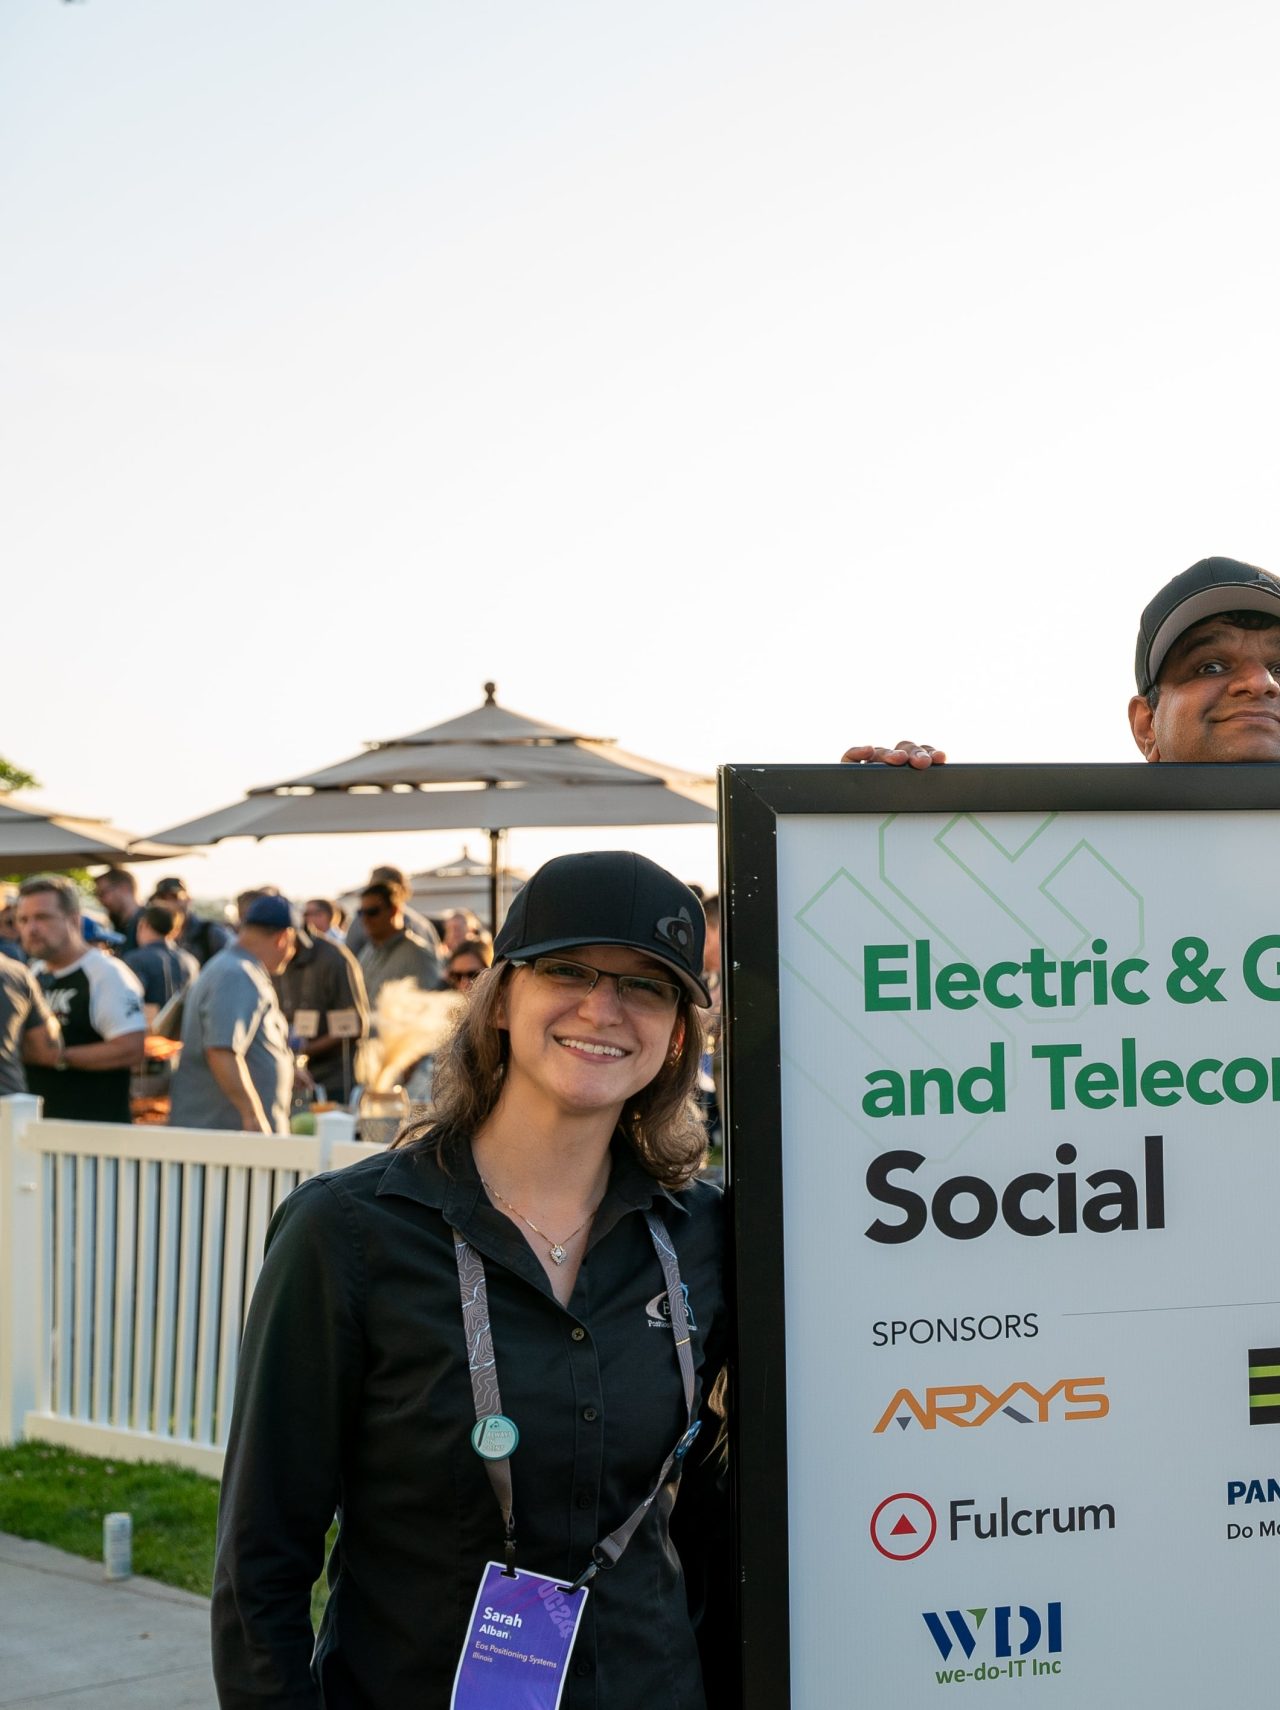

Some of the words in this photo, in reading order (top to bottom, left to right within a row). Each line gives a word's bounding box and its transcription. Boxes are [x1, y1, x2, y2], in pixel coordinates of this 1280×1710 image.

[864, 939, 1150, 1012] Electric
[1166, 937, 1227, 1004] &
[862, 1042, 1005, 1118] and
[864, 1136, 1165, 1244] Social
[873, 1313, 1038, 1346] SPONSORS
[873, 1377, 1109, 1433] ARXYS
[950, 1497, 1115, 1541] Fulcrum
[1228, 1524, 1253, 1539] Do
[479, 1623, 509, 1640] Alban
[483, 1606, 523, 1628] Sarah
[922, 1602, 1062, 1662] WDI
[472, 1651, 493, 1663] Illinois
[475, 1640, 489, 1651] Eos
[489, 1643, 528, 1662] Positioning
[528, 1654, 557, 1669] Systems
[935, 1659, 1027, 1685] we-do-IT
[1033, 1659, 1061, 1675] Inc
